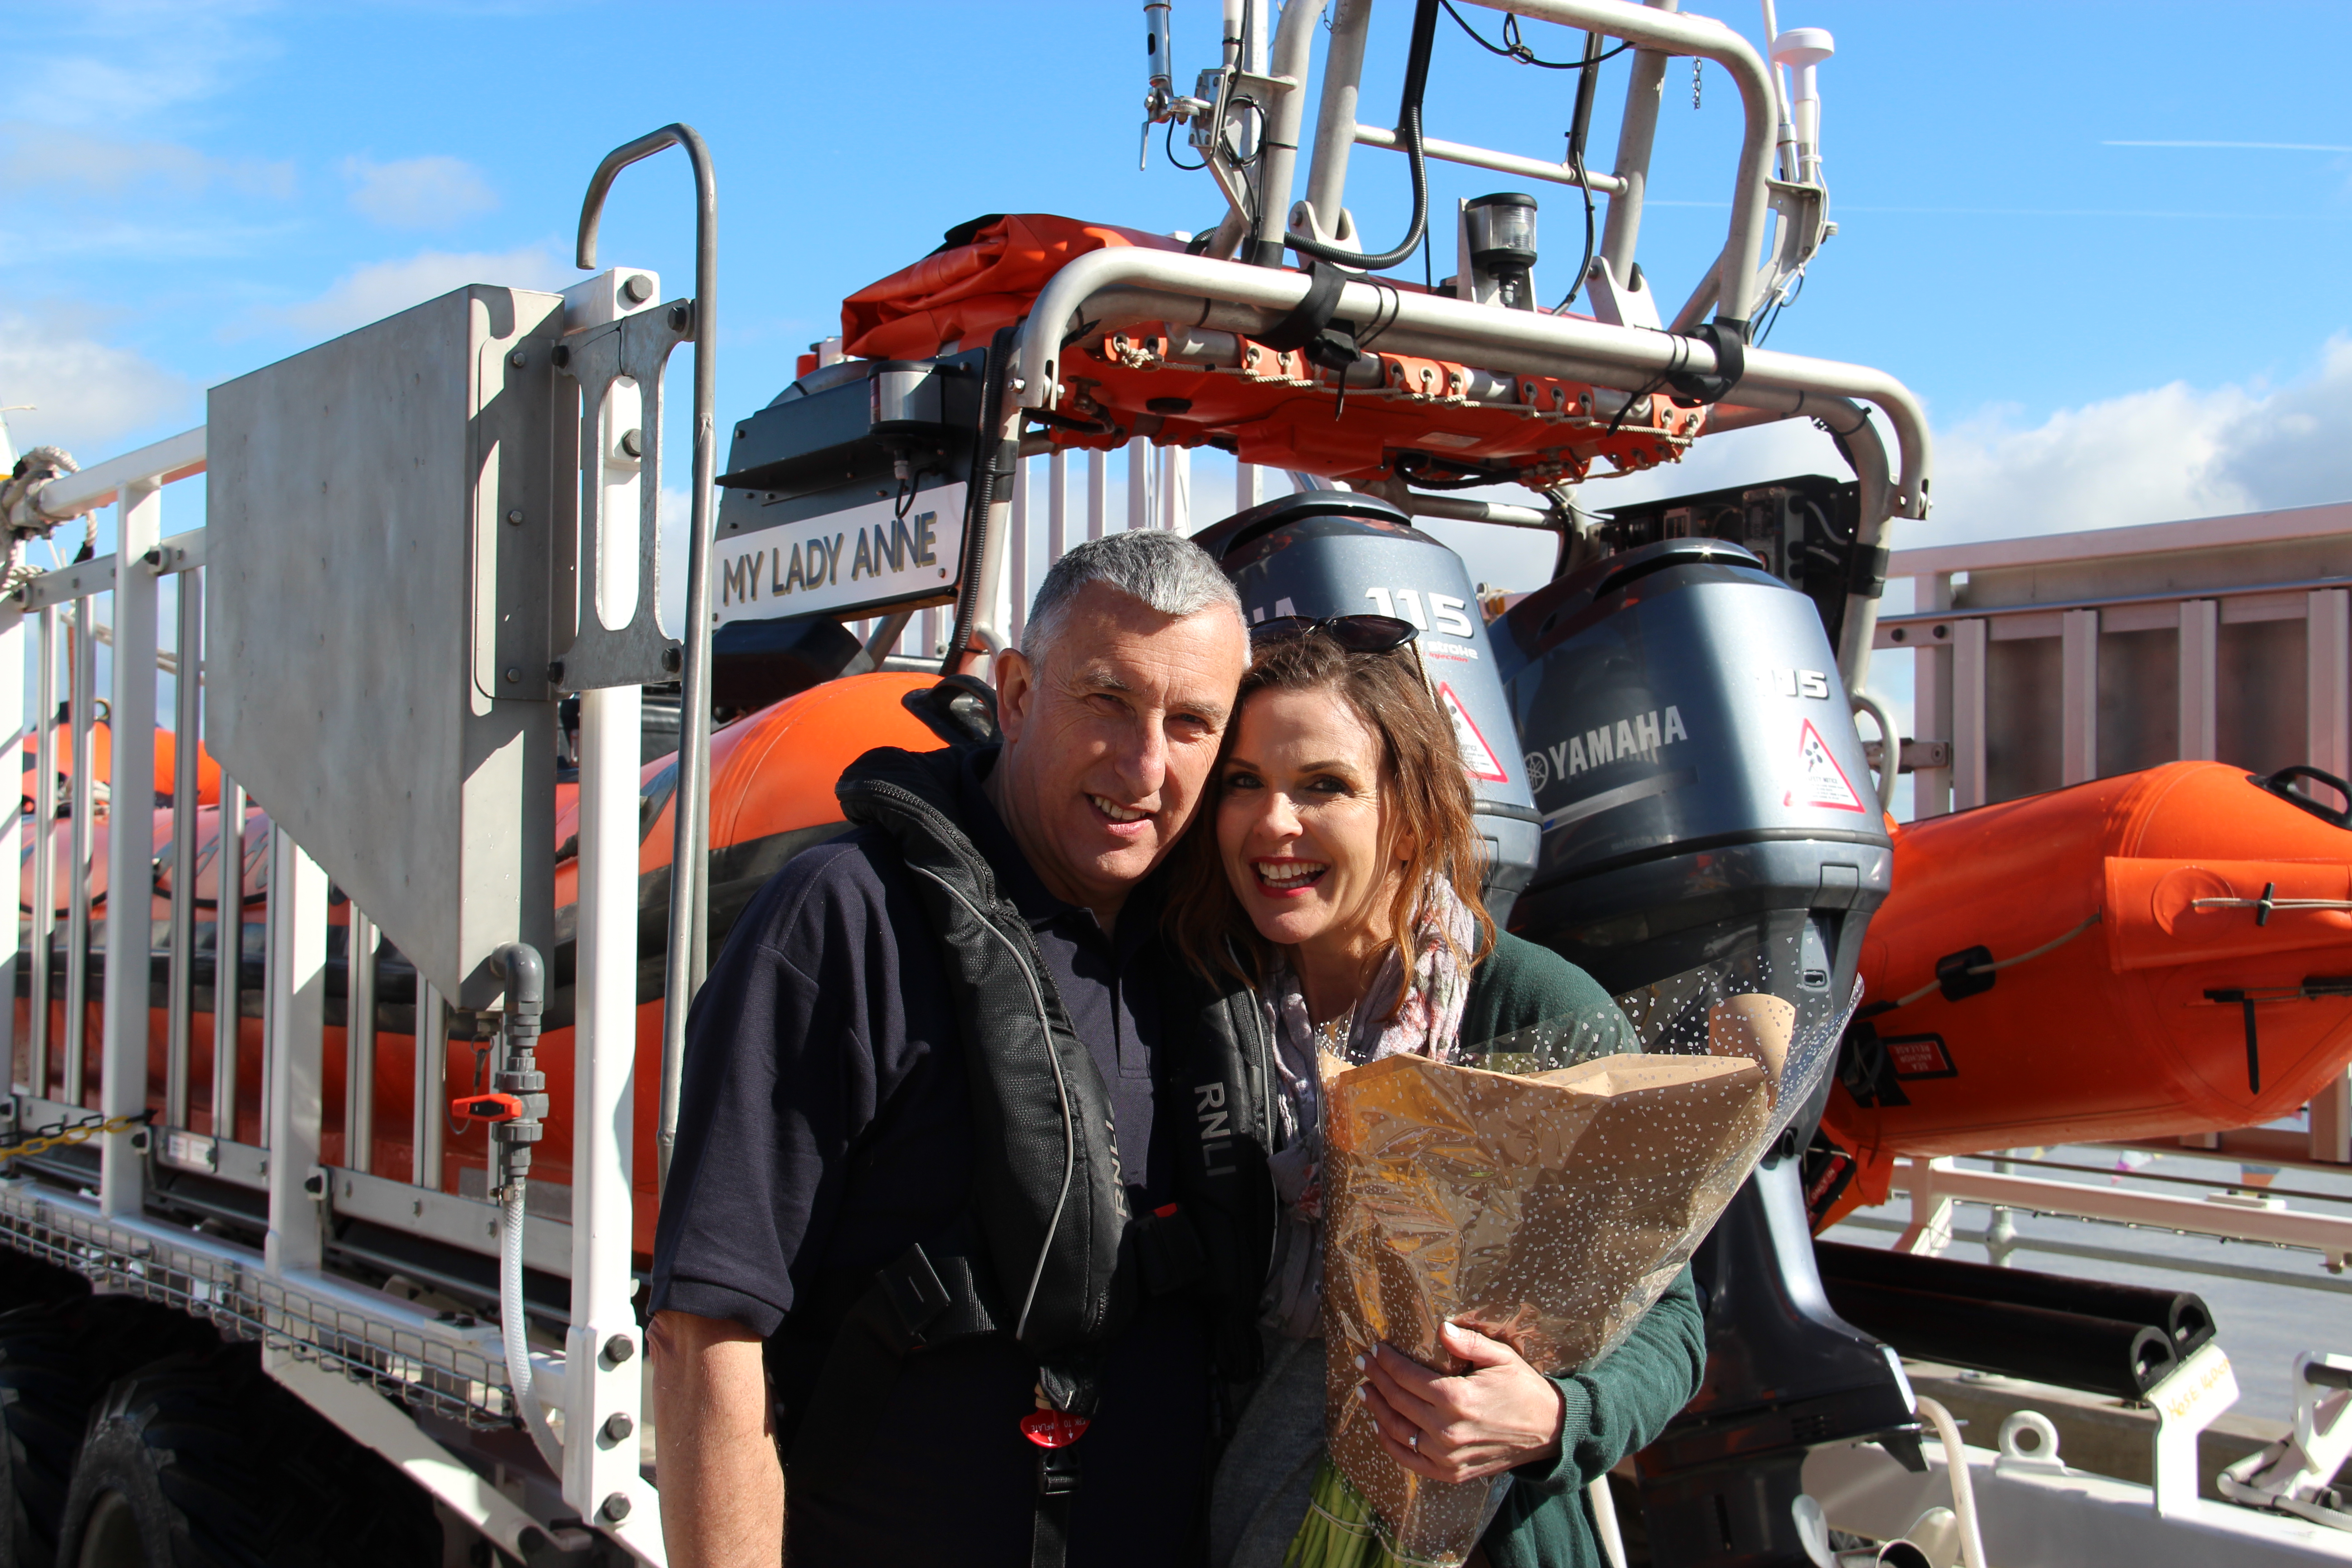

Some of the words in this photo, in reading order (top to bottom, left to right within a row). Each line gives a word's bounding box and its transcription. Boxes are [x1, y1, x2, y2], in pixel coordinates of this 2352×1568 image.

[723, 551, 764, 606] MY
[772, 533, 844, 596] LADY
[851, 511, 938, 581] ANNE
[1365, 588, 1474, 639] 115
[1427, 641, 1478, 660] stroke
[1549, 706, 1688, 780] YAMAHA
[1194, 1082, 1236, 1176] RNLI
[1031, 1422, 1054, 1433] INFLATE
